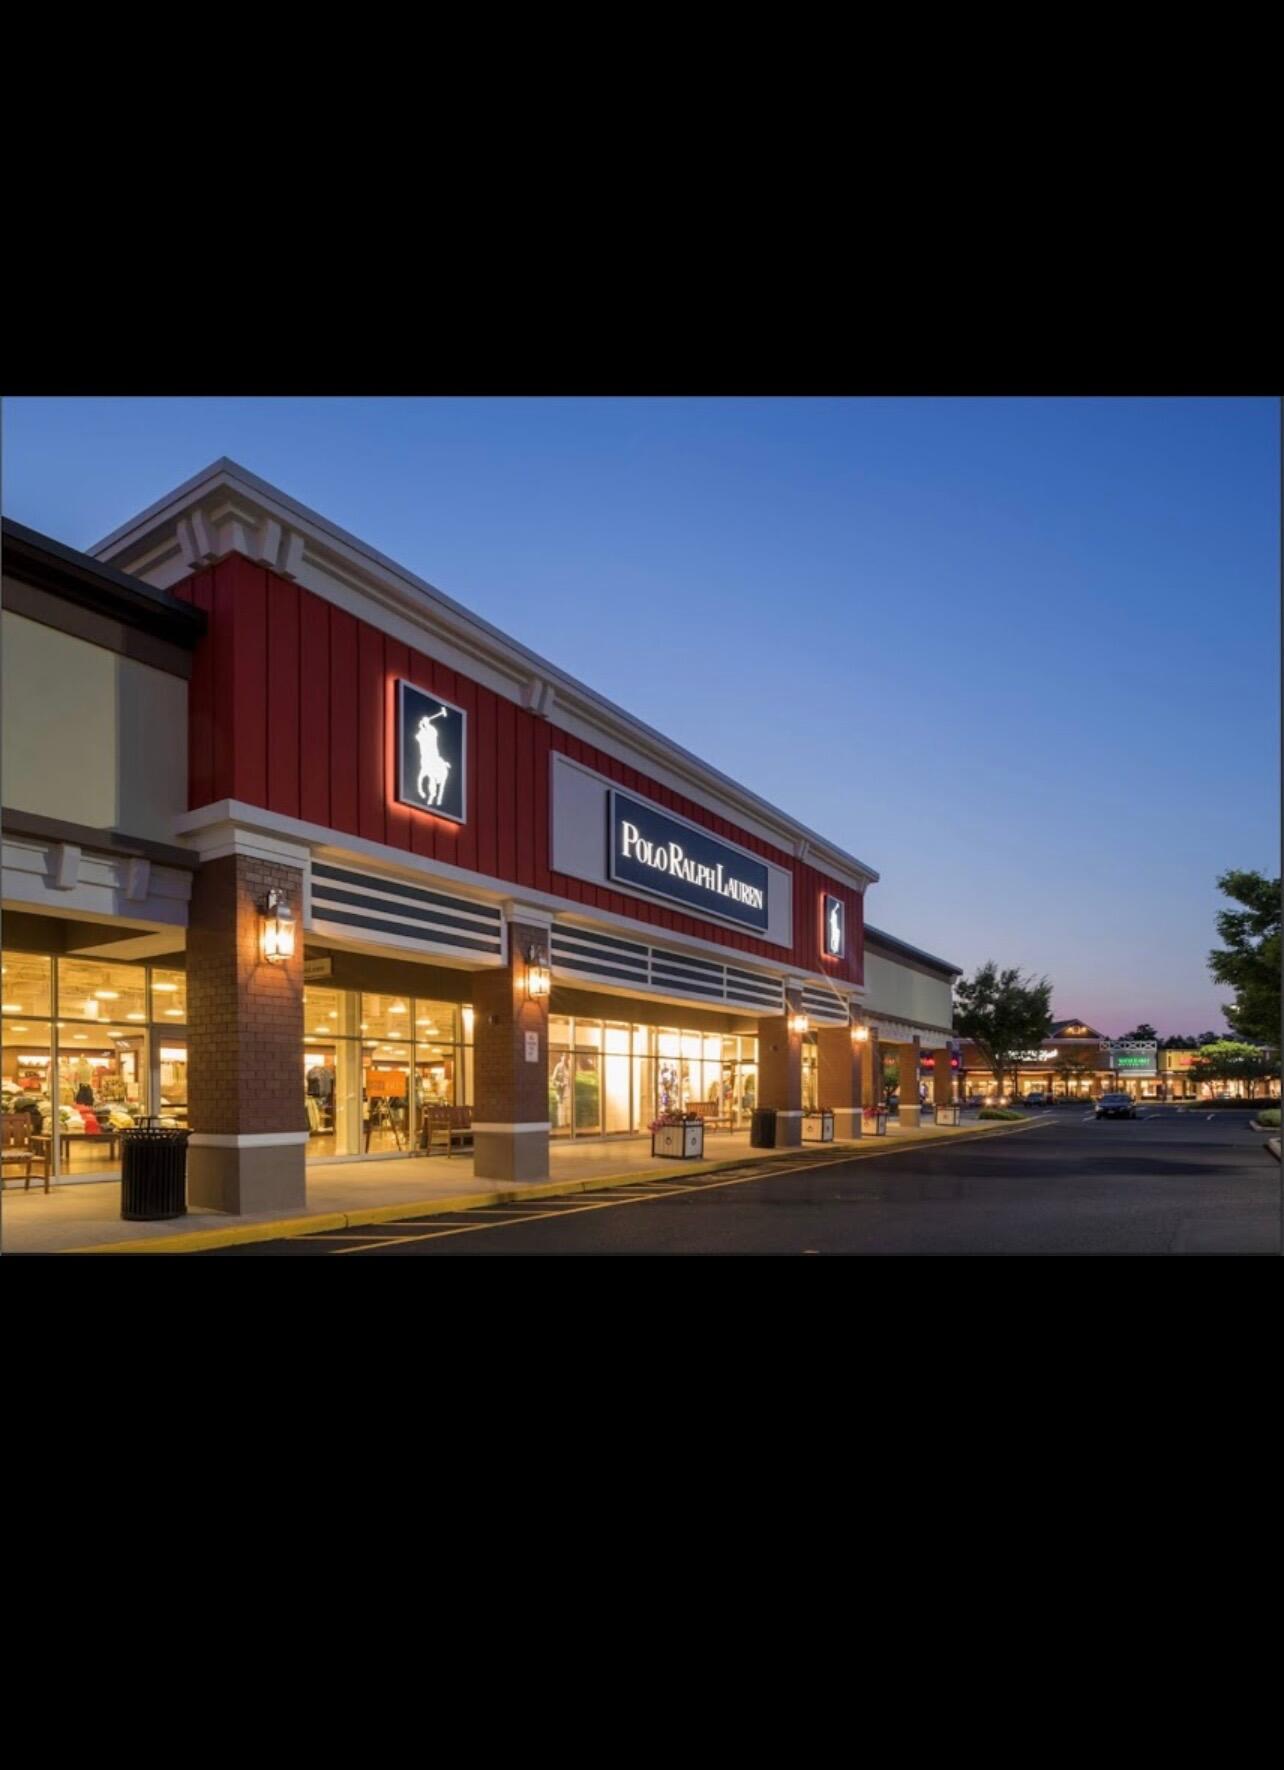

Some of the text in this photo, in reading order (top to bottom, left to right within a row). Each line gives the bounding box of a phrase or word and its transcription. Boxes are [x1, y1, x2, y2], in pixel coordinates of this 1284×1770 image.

[622, 820, 763, 910] POLO RALPH LAUREN
